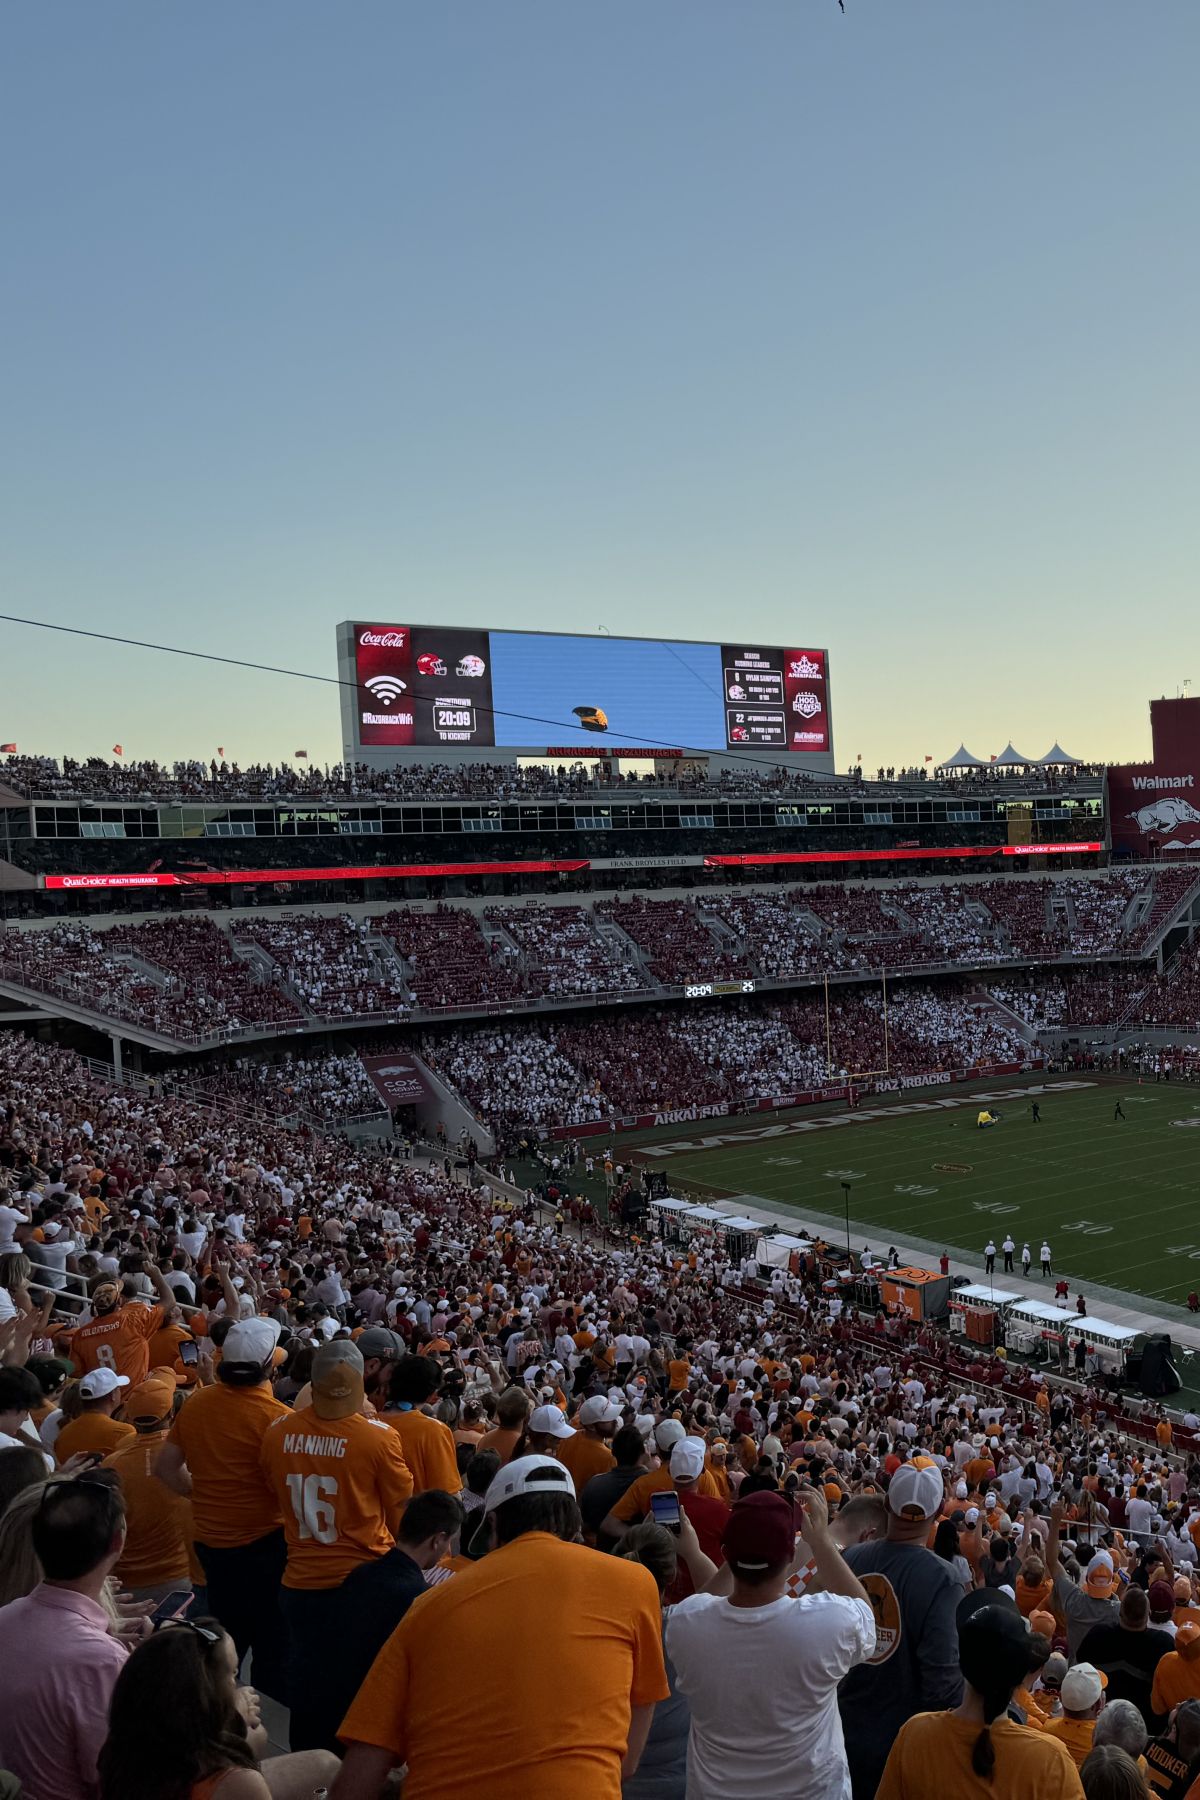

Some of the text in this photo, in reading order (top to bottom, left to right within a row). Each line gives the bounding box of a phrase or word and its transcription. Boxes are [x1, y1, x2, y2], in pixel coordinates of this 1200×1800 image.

[360, 631, 405, 647] Coca-Cola
[439, 711, 471, 726] 20:09
[736, 714, 744, 722] 22
[1132, 774, 1194, 790] Walmart
[635, 859, 666, 867] BROYLES
[686, 985, 712, 997] 20:09
[742, 981, 754, 992] 25
[384, 1078, 420, 1088] COX
[388, 1085, 422, 1093] Mobile
[875, 1072, 951, 1093] RAZRBACKS
[637, 1079, 1099, 1156] RAZORBACKS
[1060, 1220, 1114, 1234] 50
[283, 1434, 348, 1458] MANNING
[286, 1474, 338, 1544] 16
[1146, 1742, 1190, 1779] HOOKER
